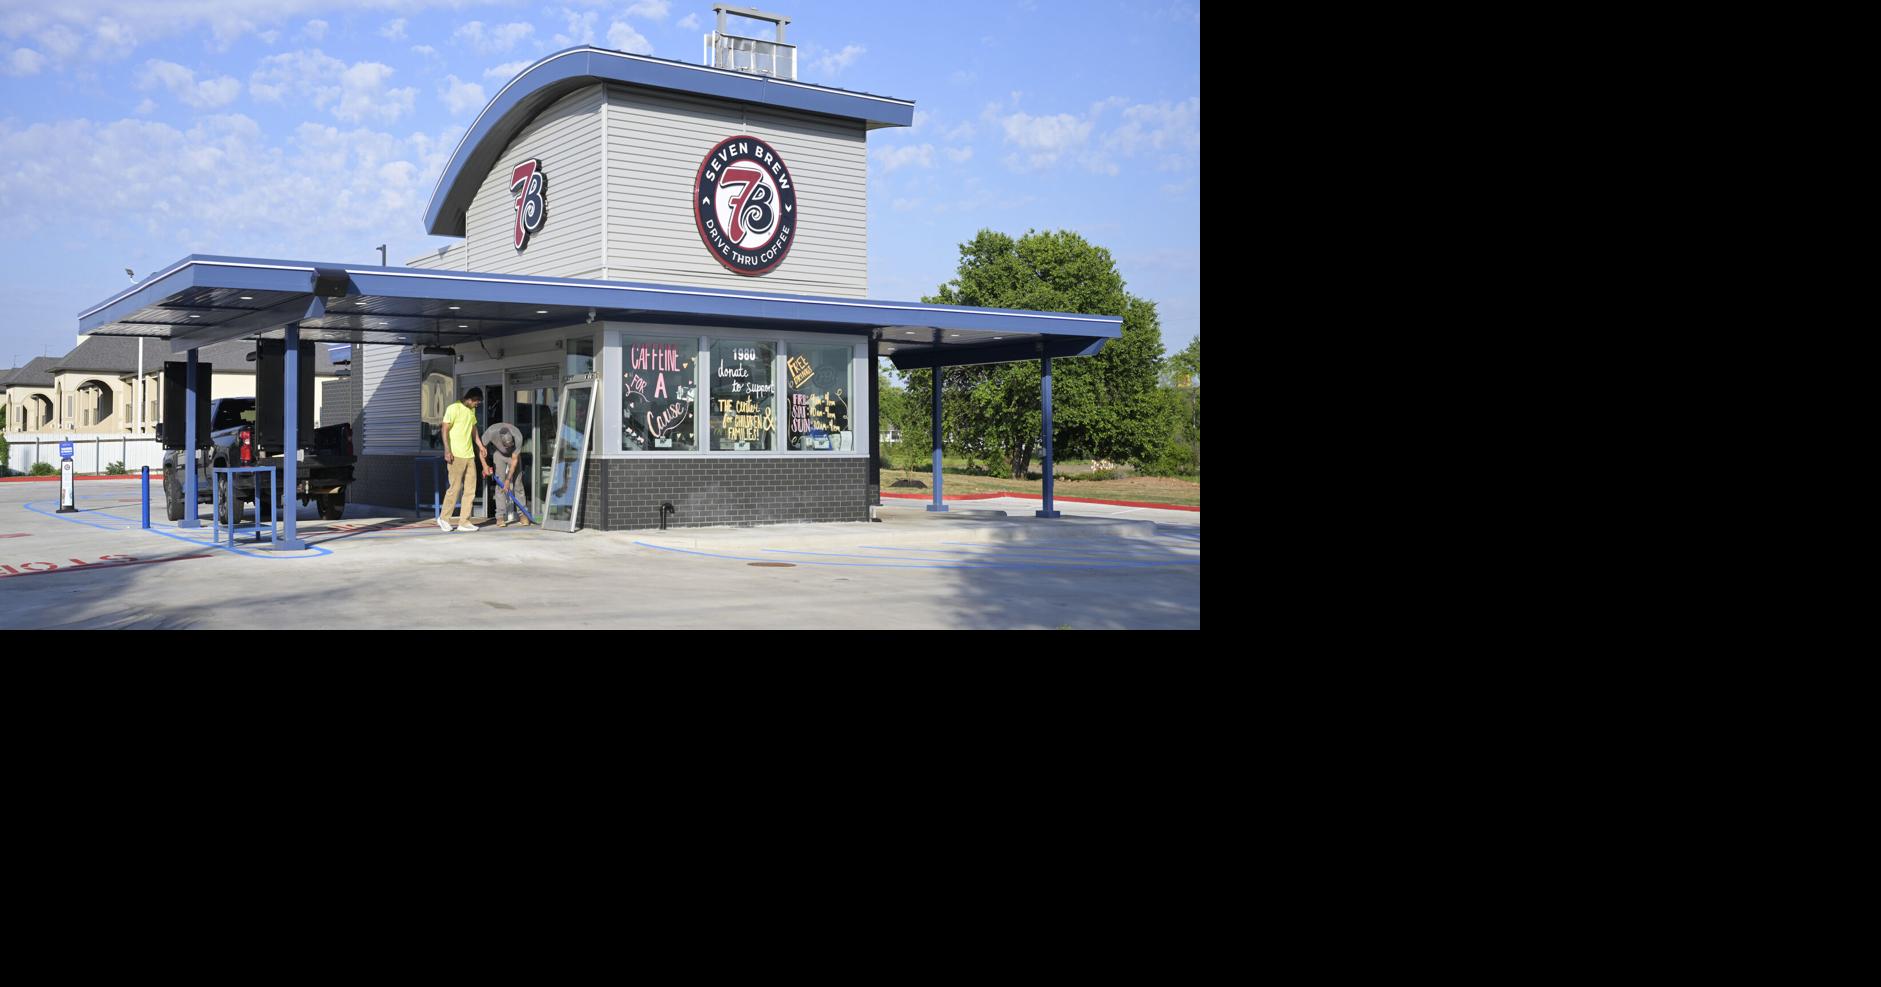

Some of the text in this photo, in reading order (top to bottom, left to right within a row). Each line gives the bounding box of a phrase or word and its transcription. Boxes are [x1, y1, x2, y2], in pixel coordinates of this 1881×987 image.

[705, 142, 790, 190] SEVEN BREW
[719, 166, 774, 245] 7B
[706, 219, 791, 266] DRIVE THRU COFFEE
[631, 343, 680, 372] CAFFEINE
[732, 347, 756, 361] 1980
[718, 359, 749, 378] donate
[630, 374, 648, 394] FOR
[654, 372, 668, 399] A
[732, 380, 775, 399] to support
[718, 399, 733, 413] THE
[647, 402, 685, 438] Cause
[763, 407, 776, 432] &
